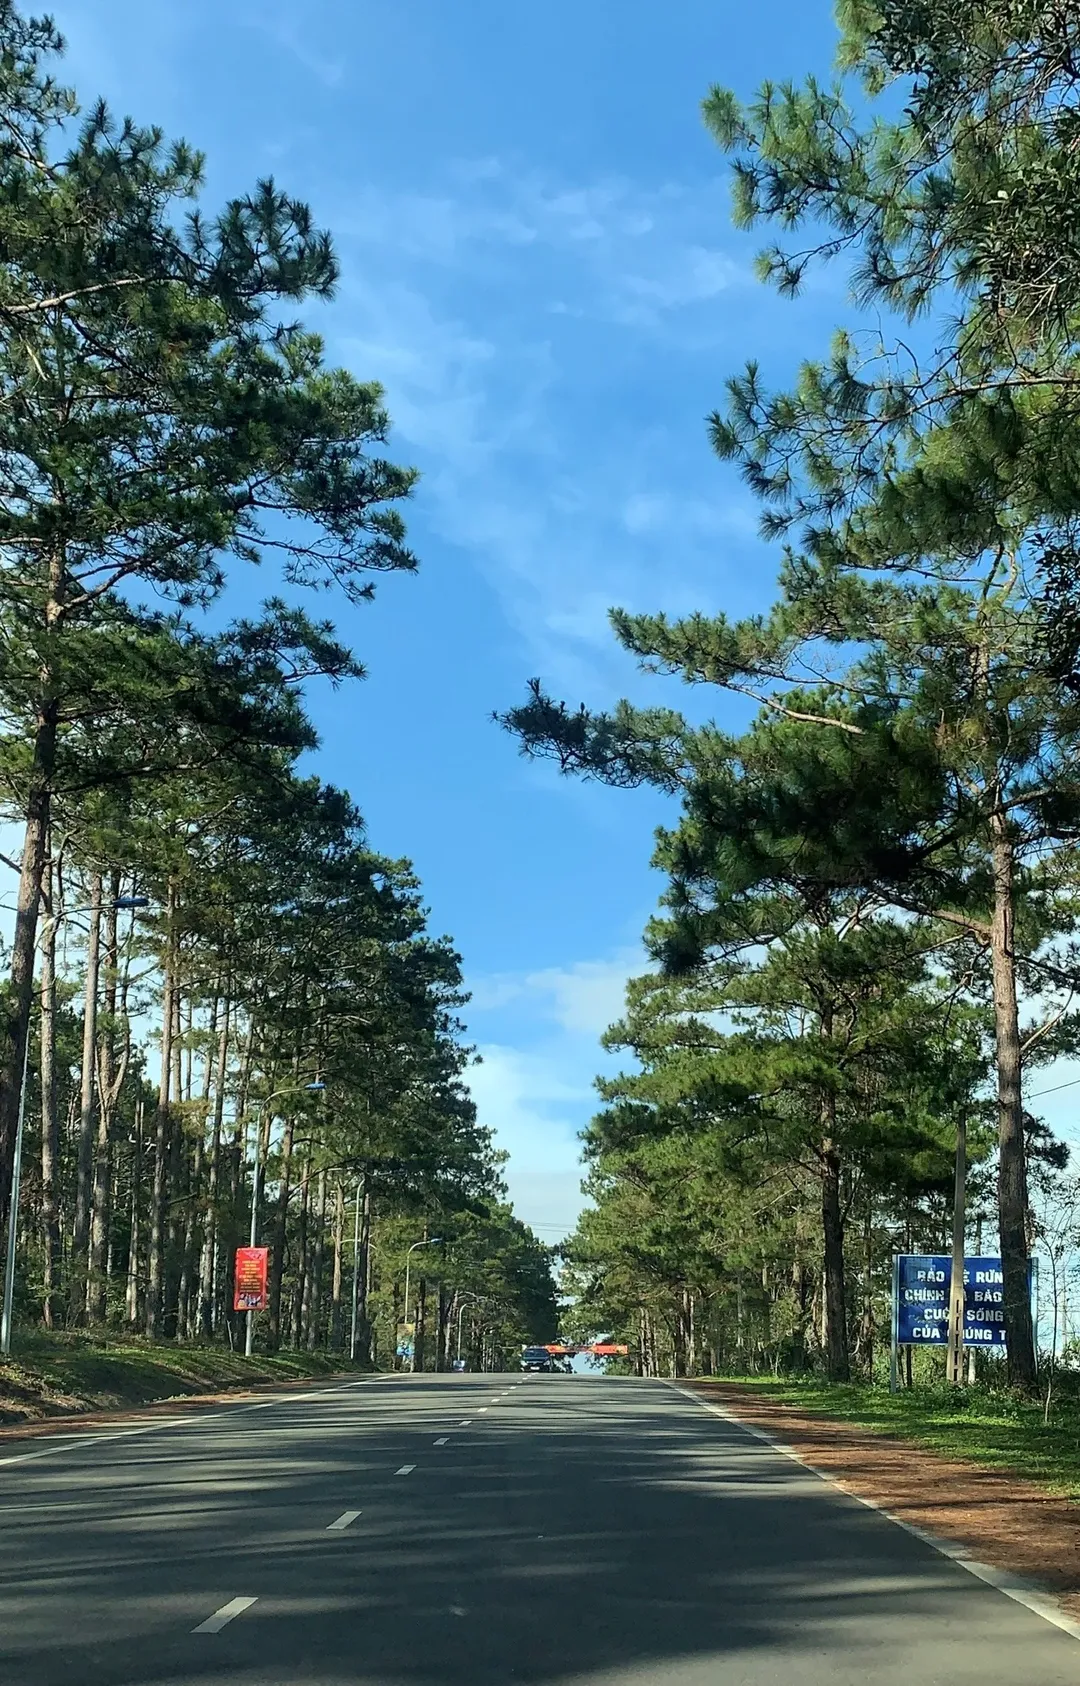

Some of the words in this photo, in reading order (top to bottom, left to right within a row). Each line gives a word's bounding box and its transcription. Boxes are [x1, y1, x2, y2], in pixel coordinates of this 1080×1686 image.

[917, 1268, 945, 1282] BẢO
[976, 1269, 1003, 1283] RỪN
[904, 1287, 945, 1301] CHÍNH
[924, 1307, 950, 1322] CUỘ
[966, 1307, 1003, 1322] SỐNG
[912, 1324, 941, 1338] CỦA
[947, 1326, 992, 1340] ÚNG
